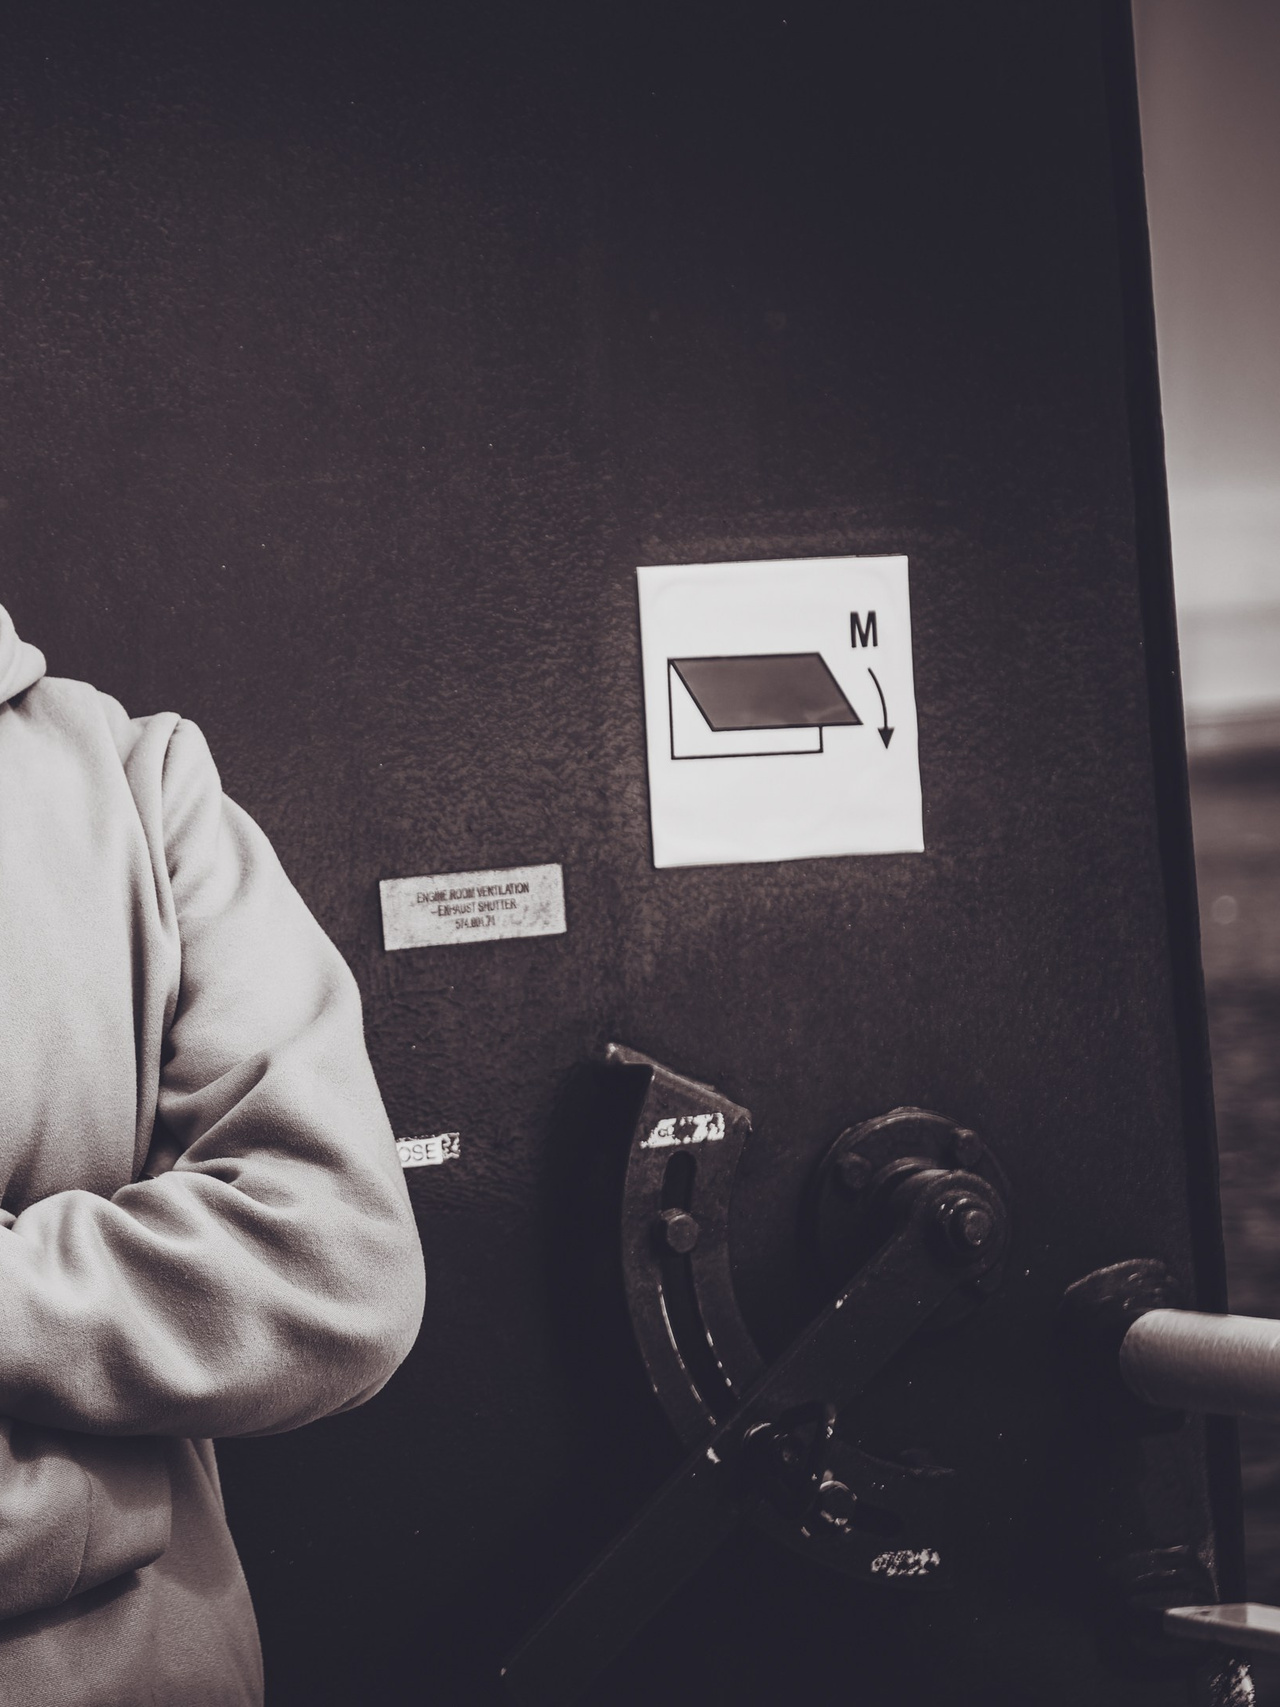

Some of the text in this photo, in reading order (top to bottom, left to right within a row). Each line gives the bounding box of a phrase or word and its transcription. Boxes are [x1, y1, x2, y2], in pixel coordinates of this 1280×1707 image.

[850, 610, 878, 648] M
[416, 882, 530, 903] ENGINE ROOM VENTILATION
[478, 898, 517, 912] SHUTTER
[398, 1142, 437, 1163] OSE
